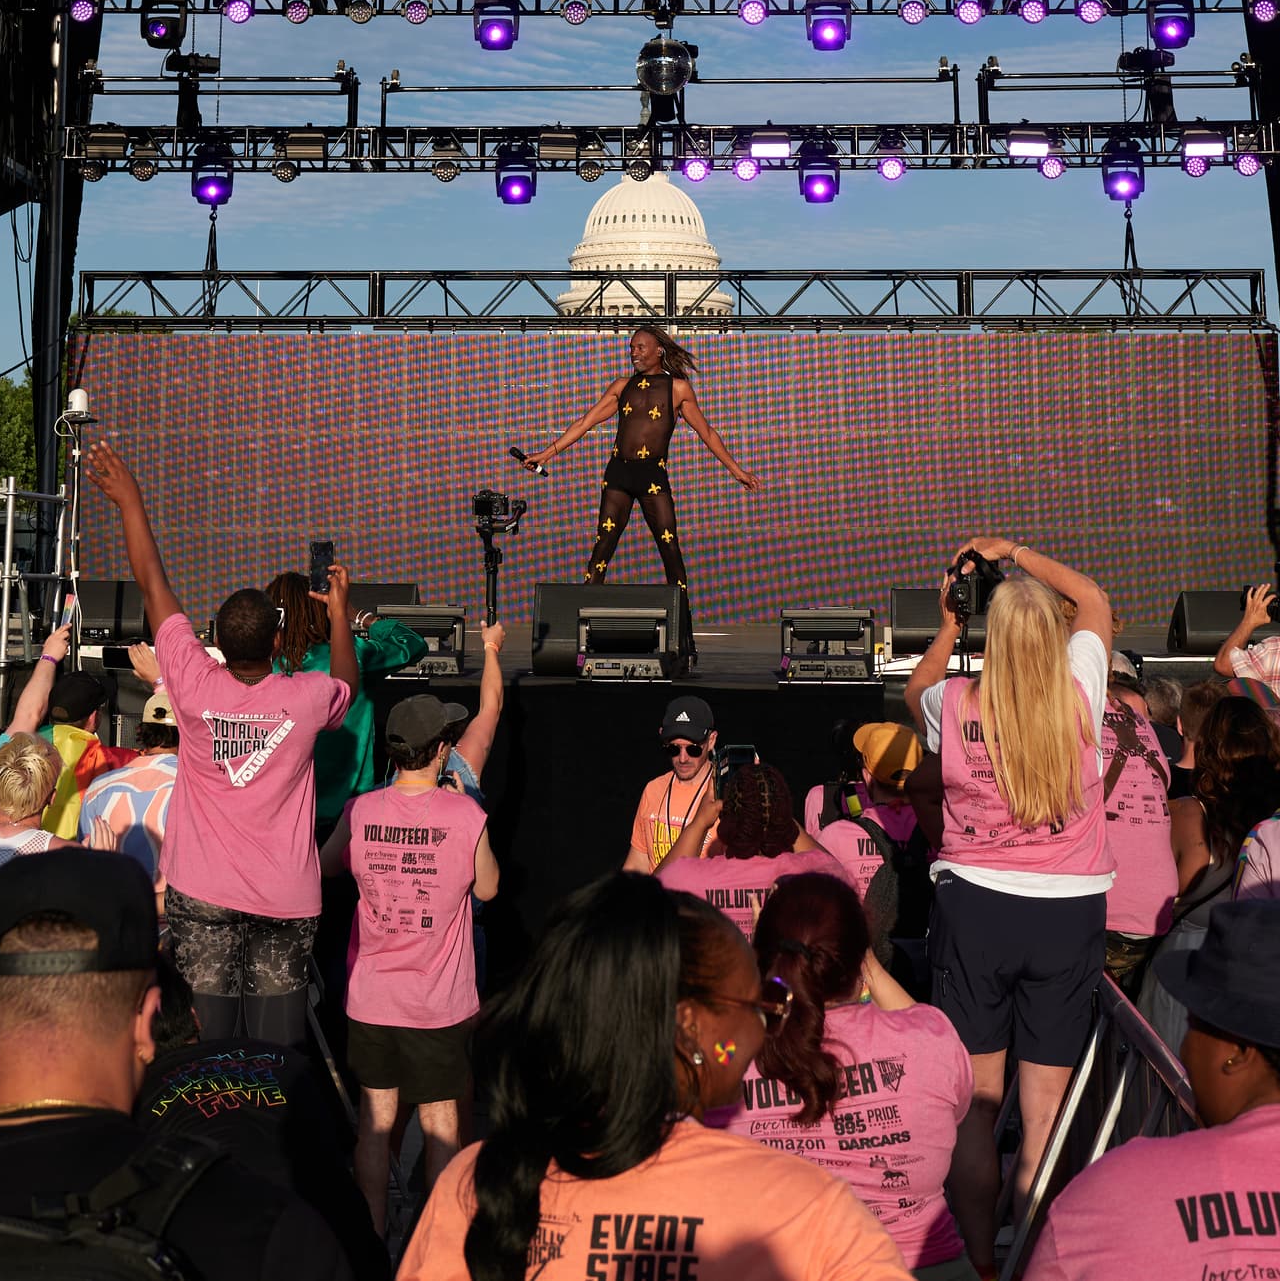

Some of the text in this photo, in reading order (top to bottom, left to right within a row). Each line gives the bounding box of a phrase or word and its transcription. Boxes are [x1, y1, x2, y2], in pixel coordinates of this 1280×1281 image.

[212, 717, 269, 740] TOTALLY
[213, 739, 267, 762] RADICAL
[233, 719, 296, 788] VOLUNTEER
[364, 824, 429, 846] VOLUNTEER
[368, 864, 396, 872] amazon
[401, 867, 438, 875] DARCARS
[705, 888, 772, 909] VOLUNT
[866, 1105, 901, 1123] PRIDE
[838, 1130, 911, 1151] DARCARS
[590, 1214, 704, 1253] EVENT
